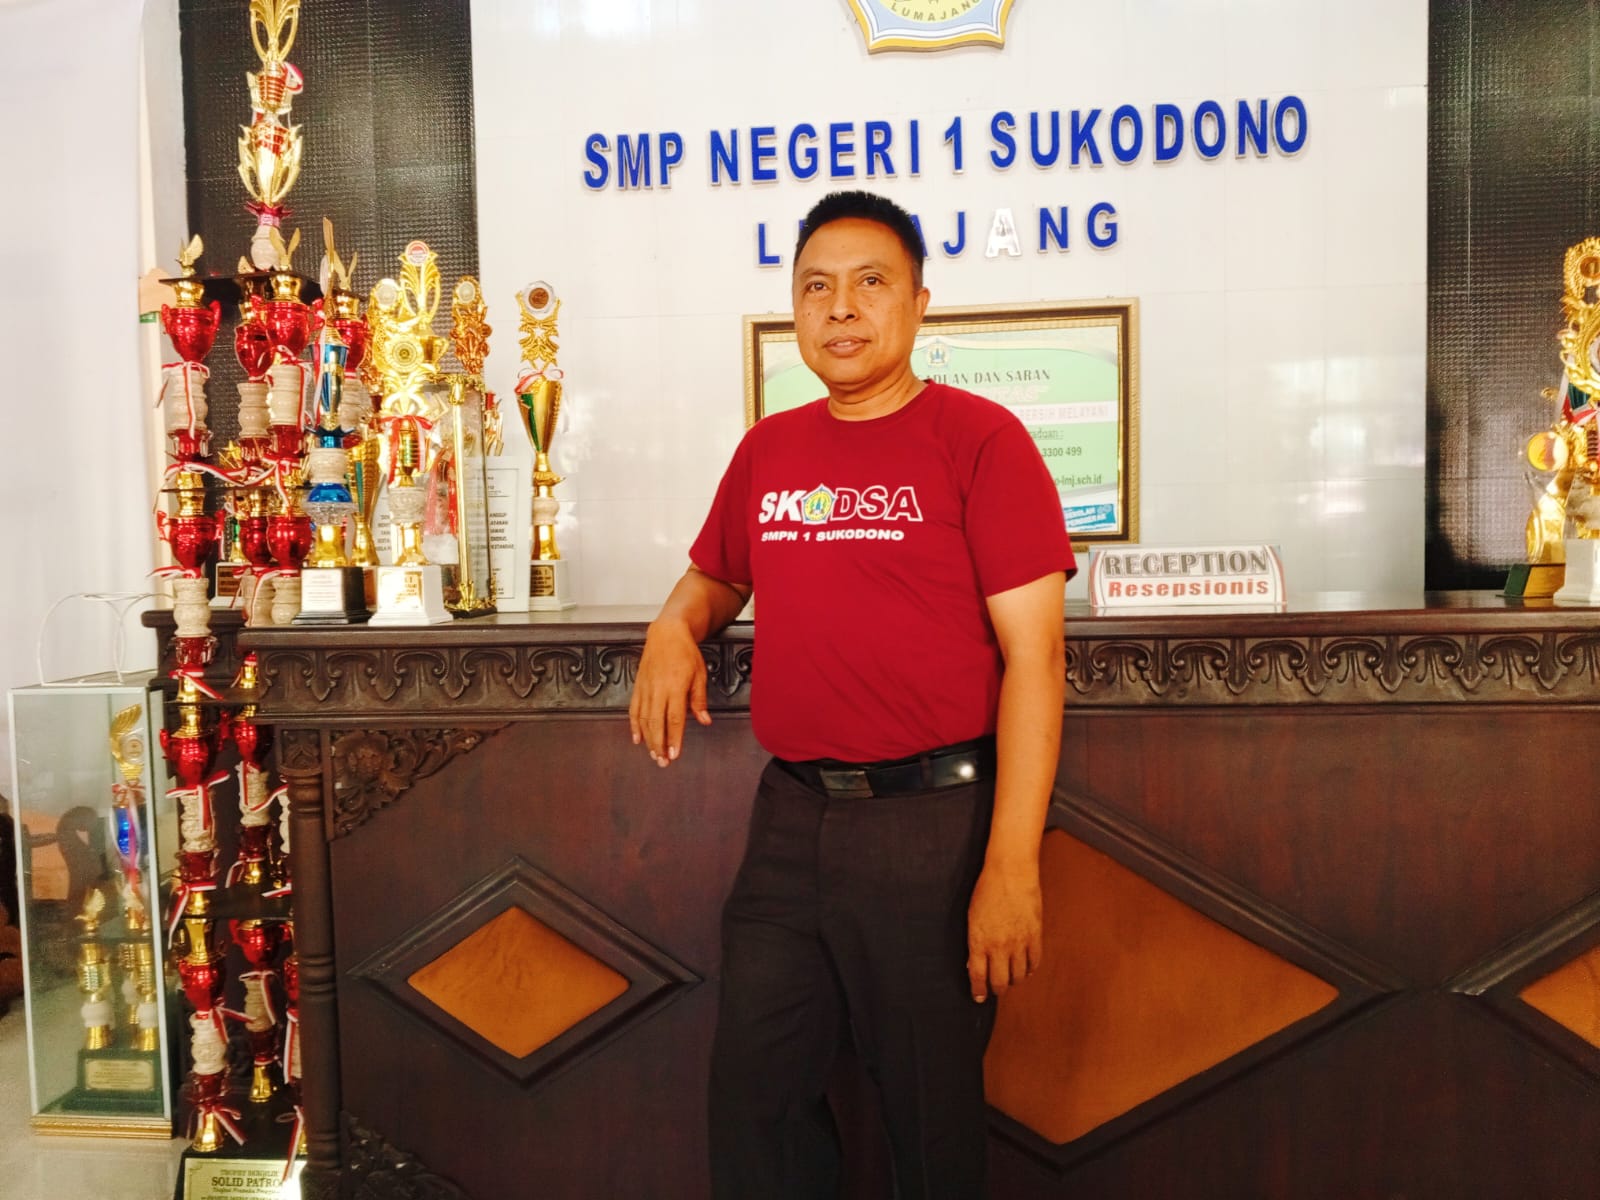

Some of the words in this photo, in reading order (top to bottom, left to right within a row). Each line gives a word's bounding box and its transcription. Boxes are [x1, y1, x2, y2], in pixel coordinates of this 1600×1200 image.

[583, 132, 686, 191] SMP
[709, 119, 920, 186] NEGERI
[943, 116, 964, 175] 1
[989, 95, 1309, 170] SUKODONO
[757, 202, 1118, 268] LJANG
[974, 371, 1001, 384] DAN
[1006, 368, 1051, 383] SARAN
[1066, 446, 1082, 456] 499
[761, 530, 798, 542] SMPN
[803, 531, 811, 542] 1
[815, 528, 905, 542] SUKODONO
[1103, 550, 1270, 577] RECEPTION
[1107, 578, 1270, 598] Resepsionis
[211, 1176, 244, 1187] SOLID
